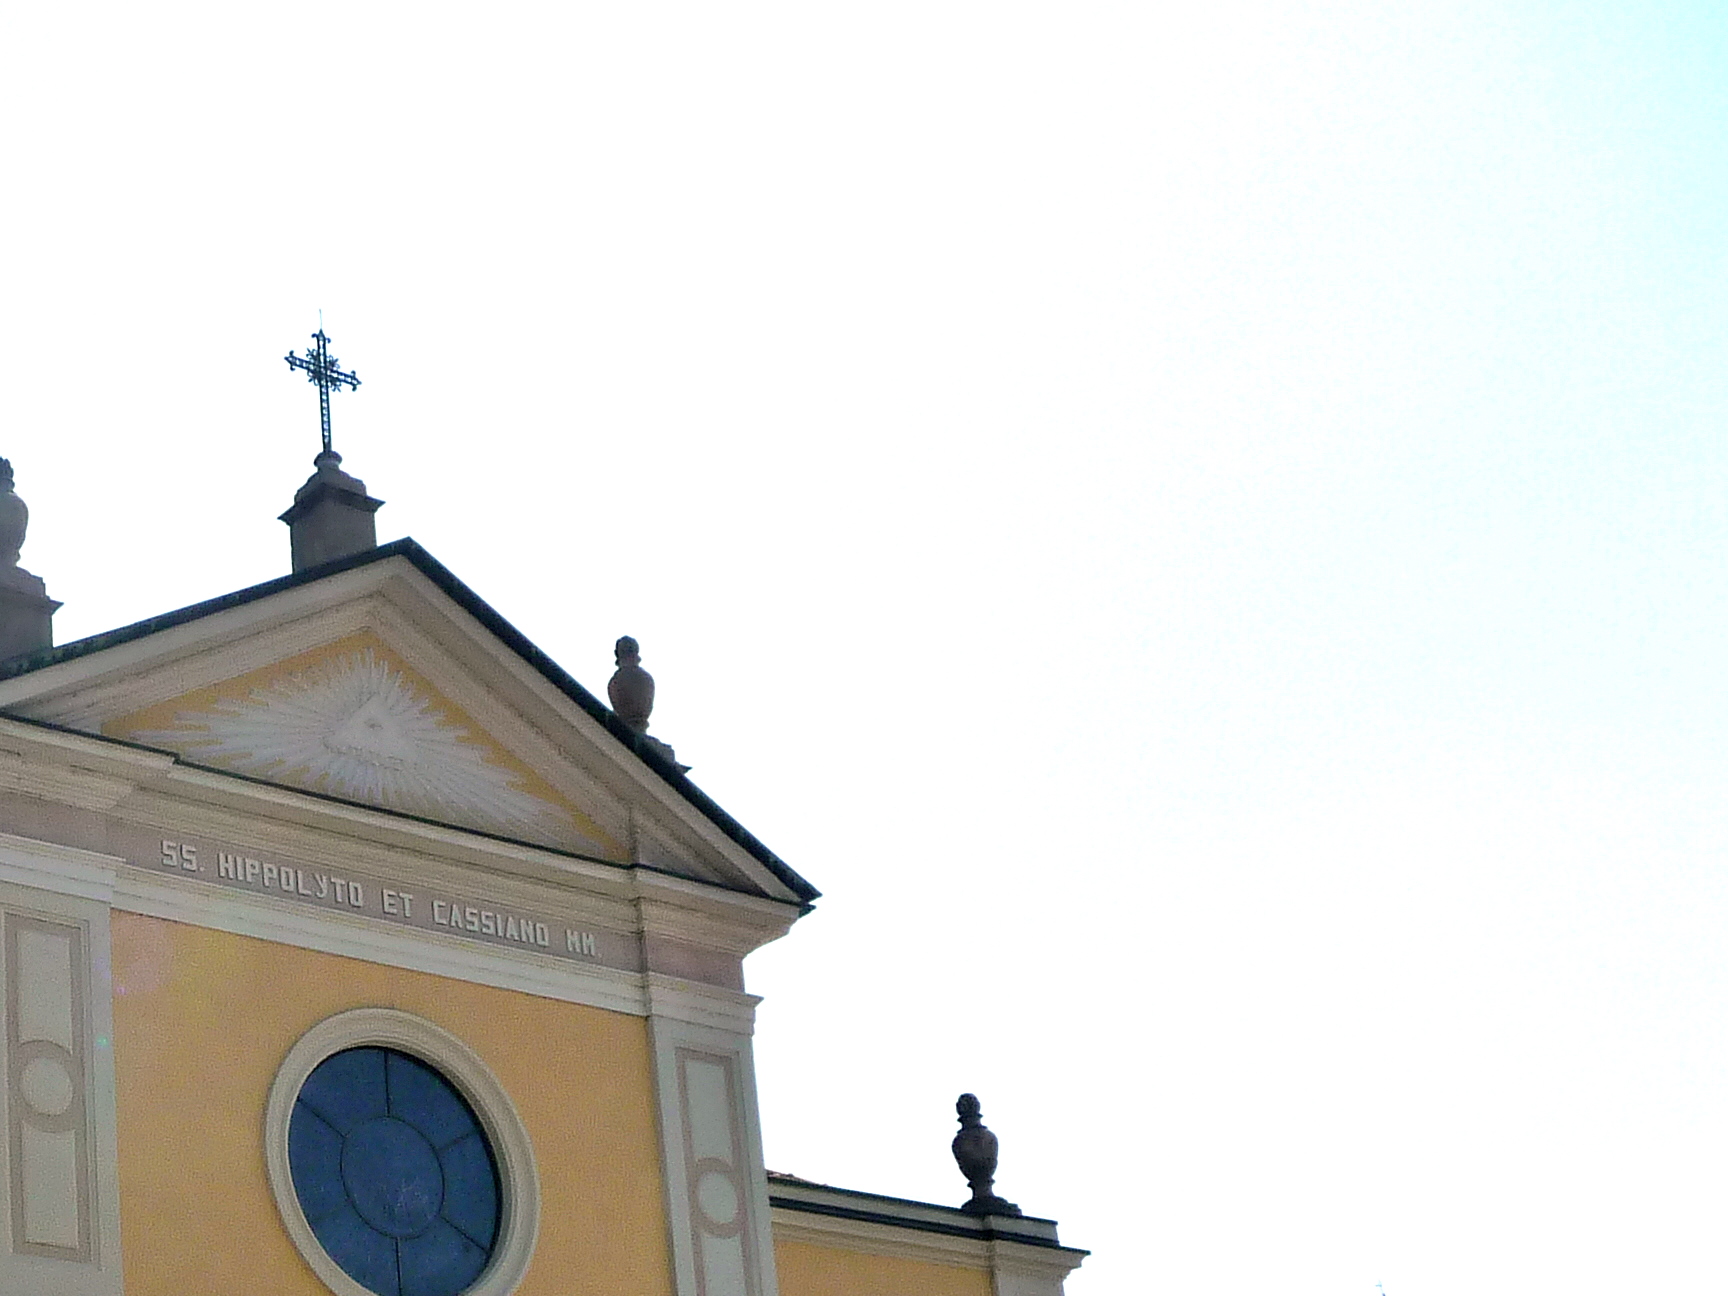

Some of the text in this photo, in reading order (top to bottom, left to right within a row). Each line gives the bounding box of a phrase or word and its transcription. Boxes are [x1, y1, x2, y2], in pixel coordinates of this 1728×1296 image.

[217, 853, 364, 908] HIPPOLYTO
[381, 888, 413, 918] ET
[431, 900, 550, 947] CASSIANO
